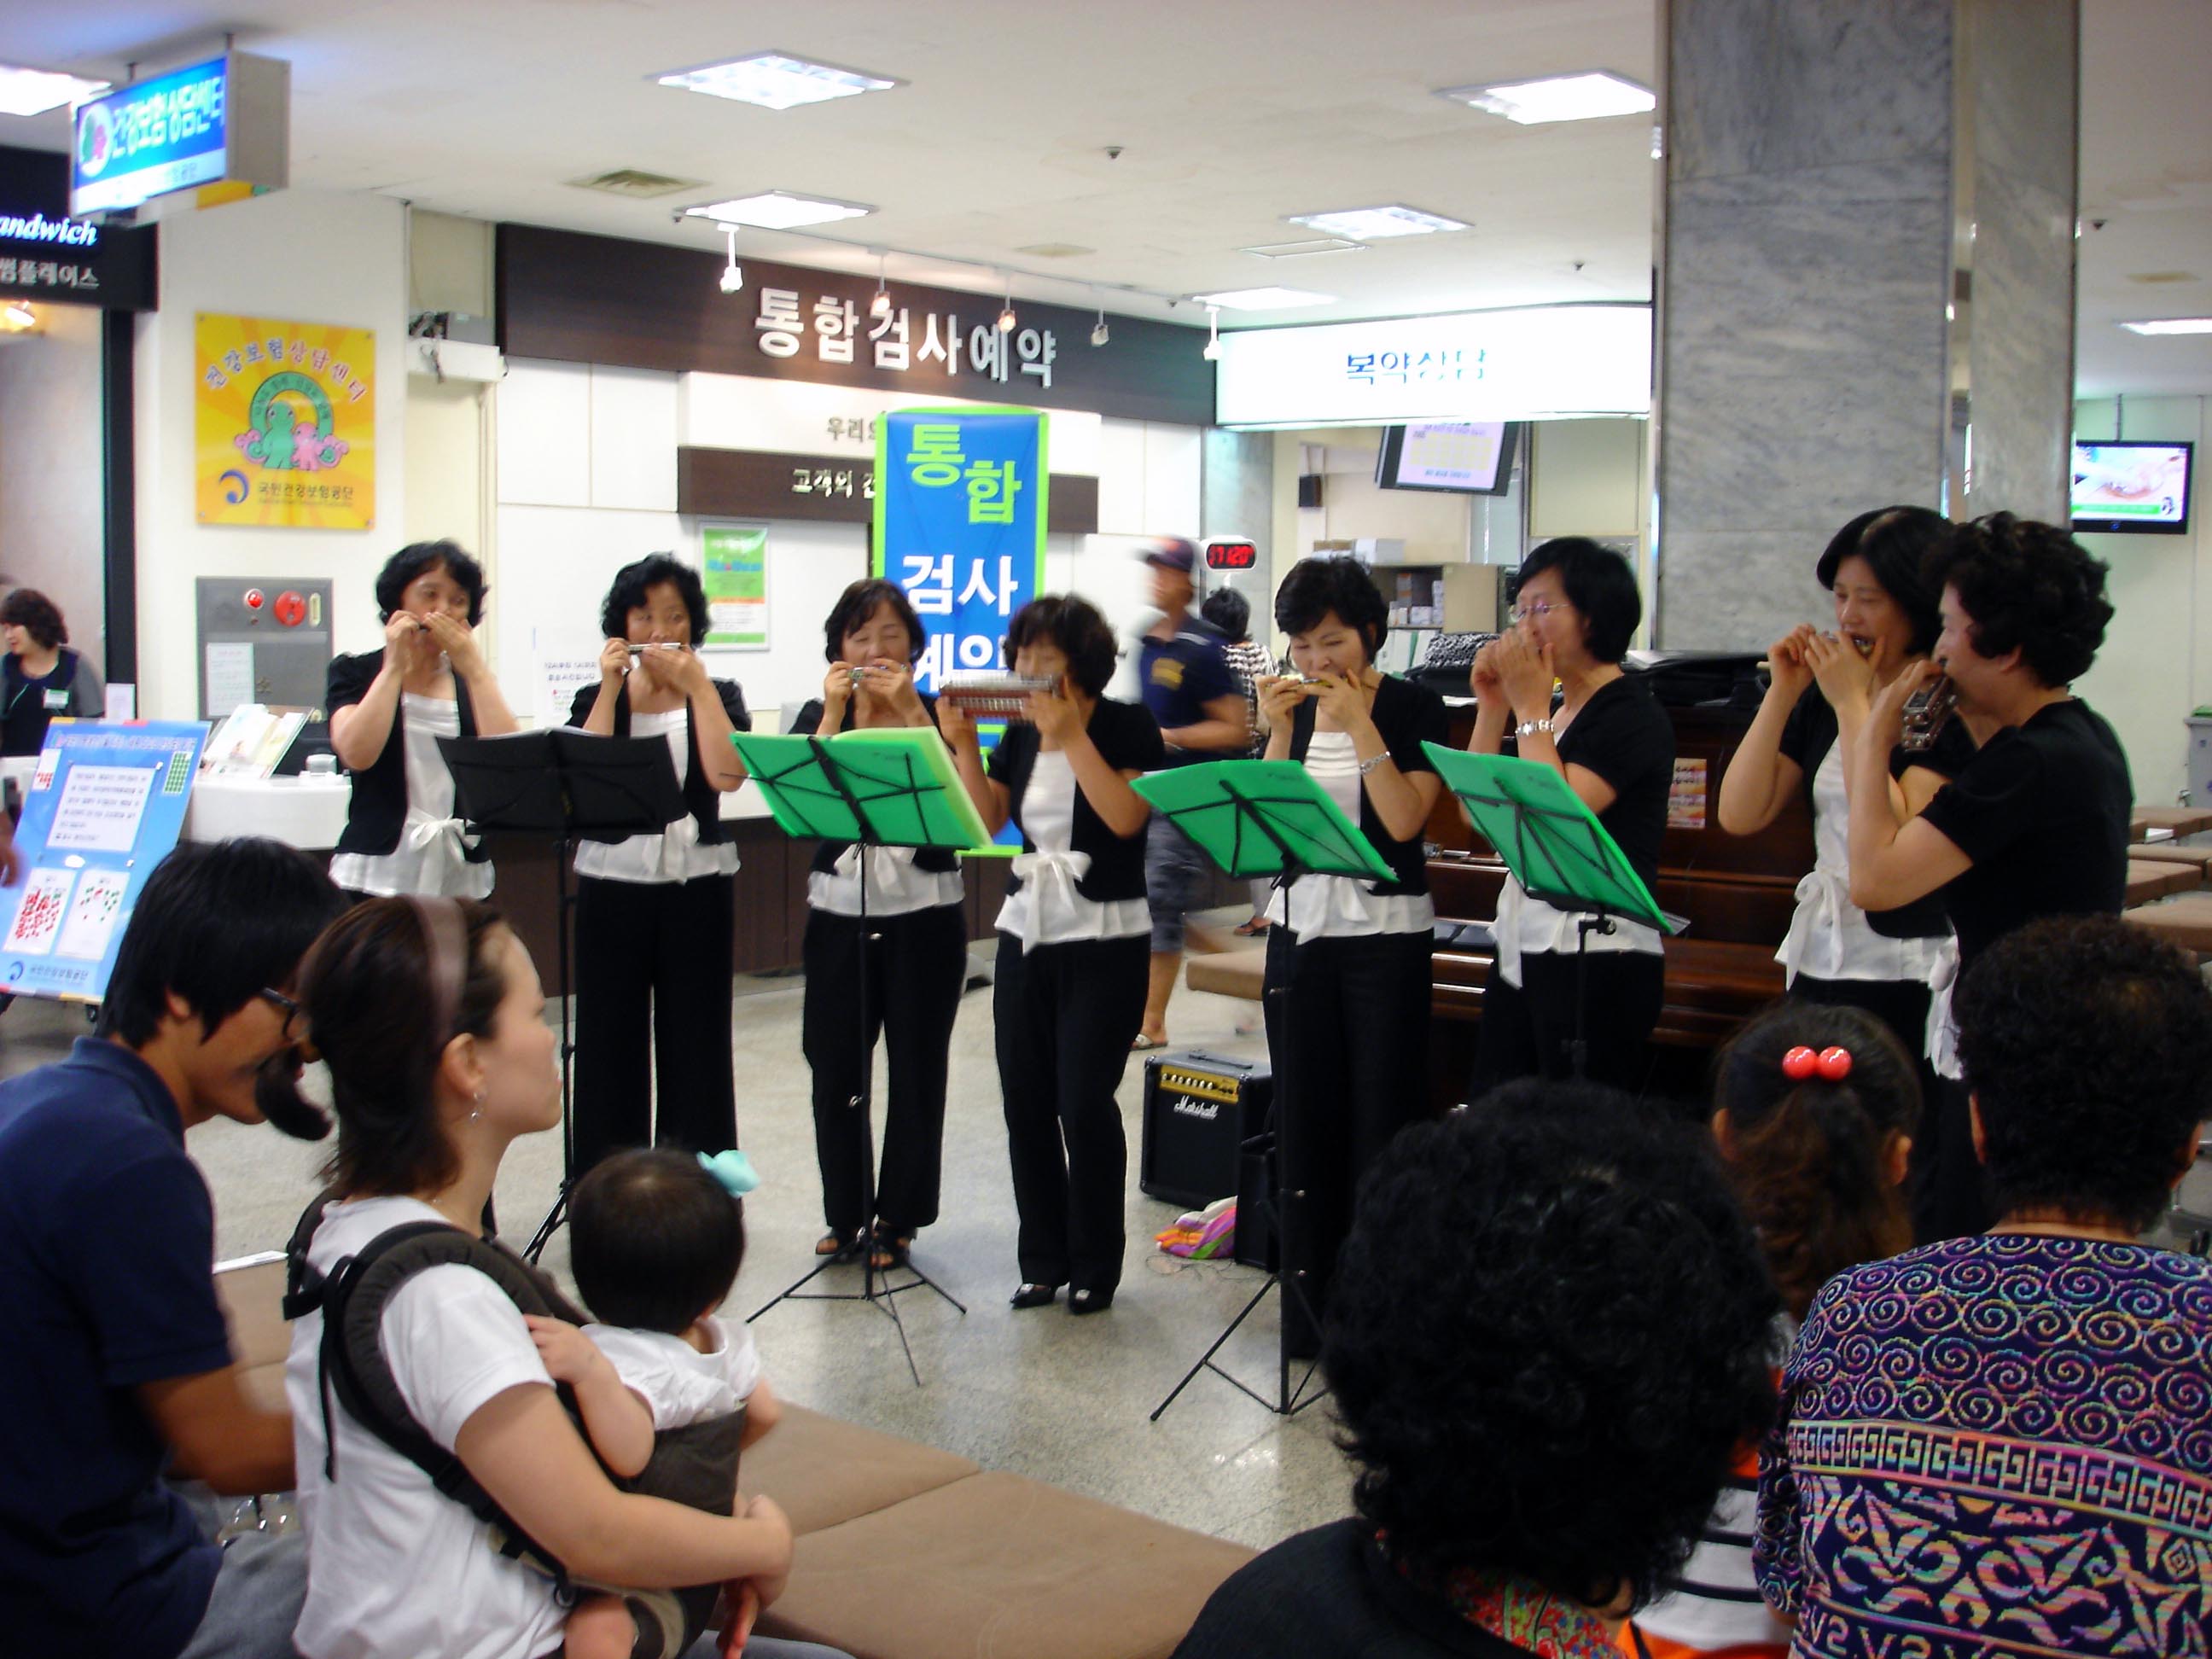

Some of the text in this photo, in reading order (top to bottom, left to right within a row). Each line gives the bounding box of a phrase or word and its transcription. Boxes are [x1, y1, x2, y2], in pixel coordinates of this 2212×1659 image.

[755, 287, 1057, 389] 통합검사예약
[1347, 349, 1487, 385] 복약상담
[901, 554, 1019, 617] 검사
[1173, 1095, 1219, 1120] Marshall
